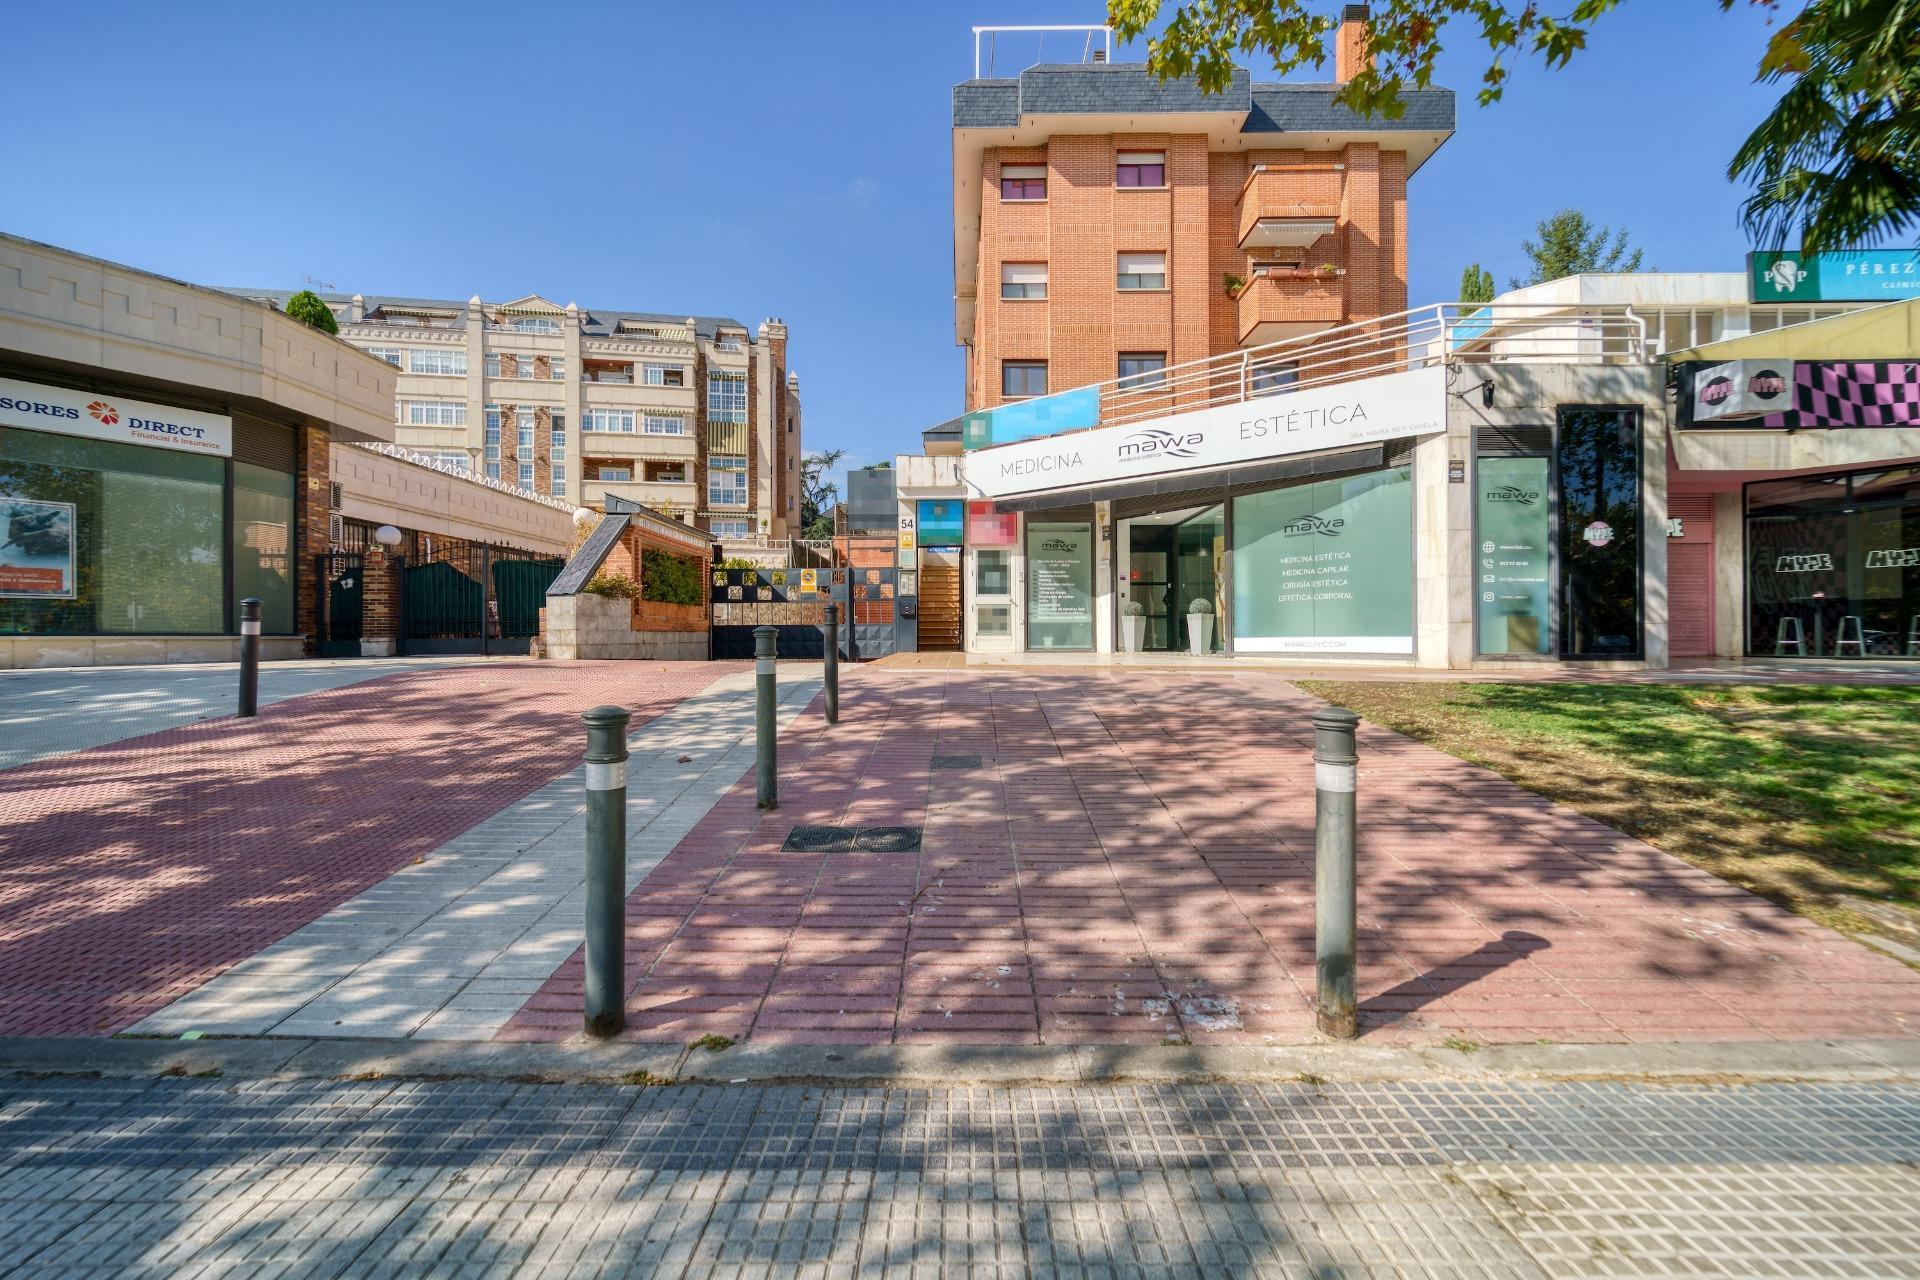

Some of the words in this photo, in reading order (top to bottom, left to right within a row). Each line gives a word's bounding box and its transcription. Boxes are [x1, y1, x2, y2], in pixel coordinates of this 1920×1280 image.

[1846, 261, 1915, 276] PÉREZ
[128, 417, 205, 439] DIRECT
[131, 430, 171, 442] Financial
[172, 435, 179, 443] &
[181, 438, 221, 450] Insurance
[1001, 452, 1083, 478] MEDICINA
[1118, 432, 1204, 457] mawa
[1240, 403, 1368, 440] ESTÉTICA
[901, 519, 914, 529] 54
[1284, 518, 1345, 534] mawa
[1280, 555, 1313, 564] MEDICINA
[1314, 552, 1351, 562] ESTÉTICA
[1282, 568, 1316, 577] MEDICINA
[1317, 565, 1349, 574] CAPILAR
[1282, 580, 1311, 590] CIRUGÍA
[1312, 578, 1348, 588] ESTÉTICA
[1313, 591, 1353, 601] CORPORAL
